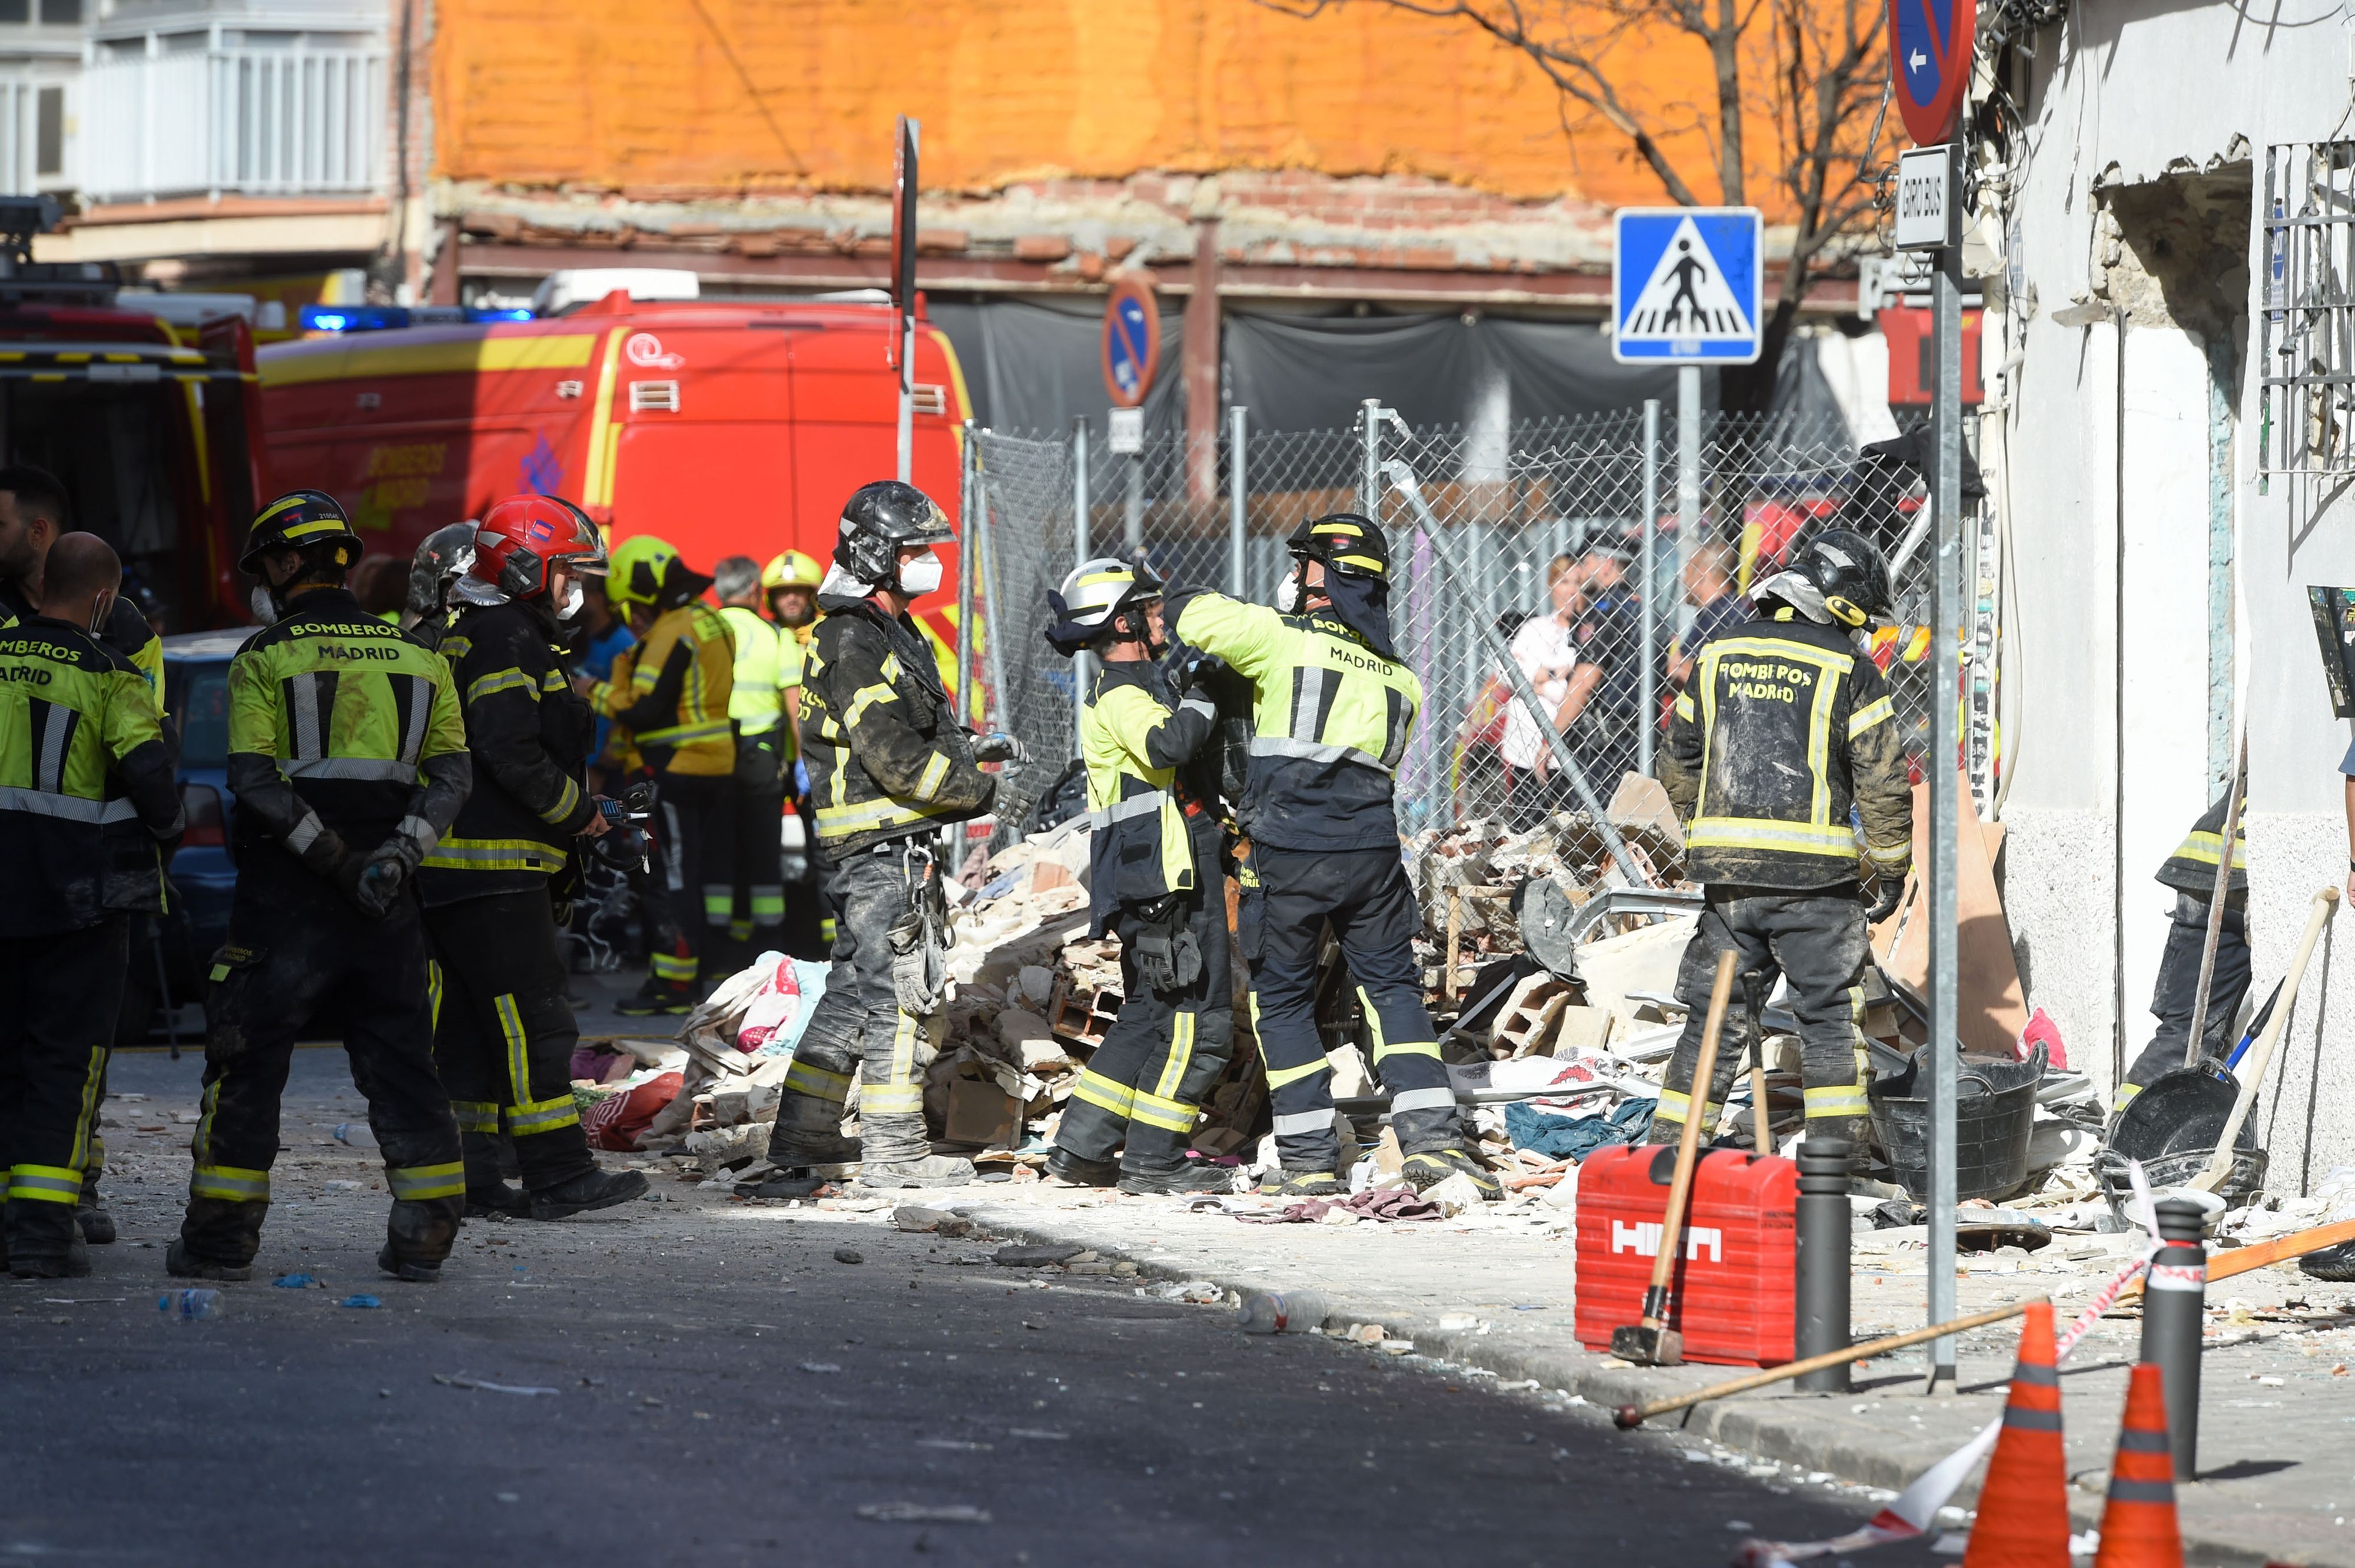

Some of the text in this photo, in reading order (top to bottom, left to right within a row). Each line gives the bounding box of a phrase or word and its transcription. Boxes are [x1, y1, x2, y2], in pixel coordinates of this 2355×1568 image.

[1902, 176, 1942, 218] GIRO BUS
[289, 624, 402, 638] BOMBEROS
[317, 645, 400, 660] MADRID
[1331, 647, 1393, 676] MADRID
